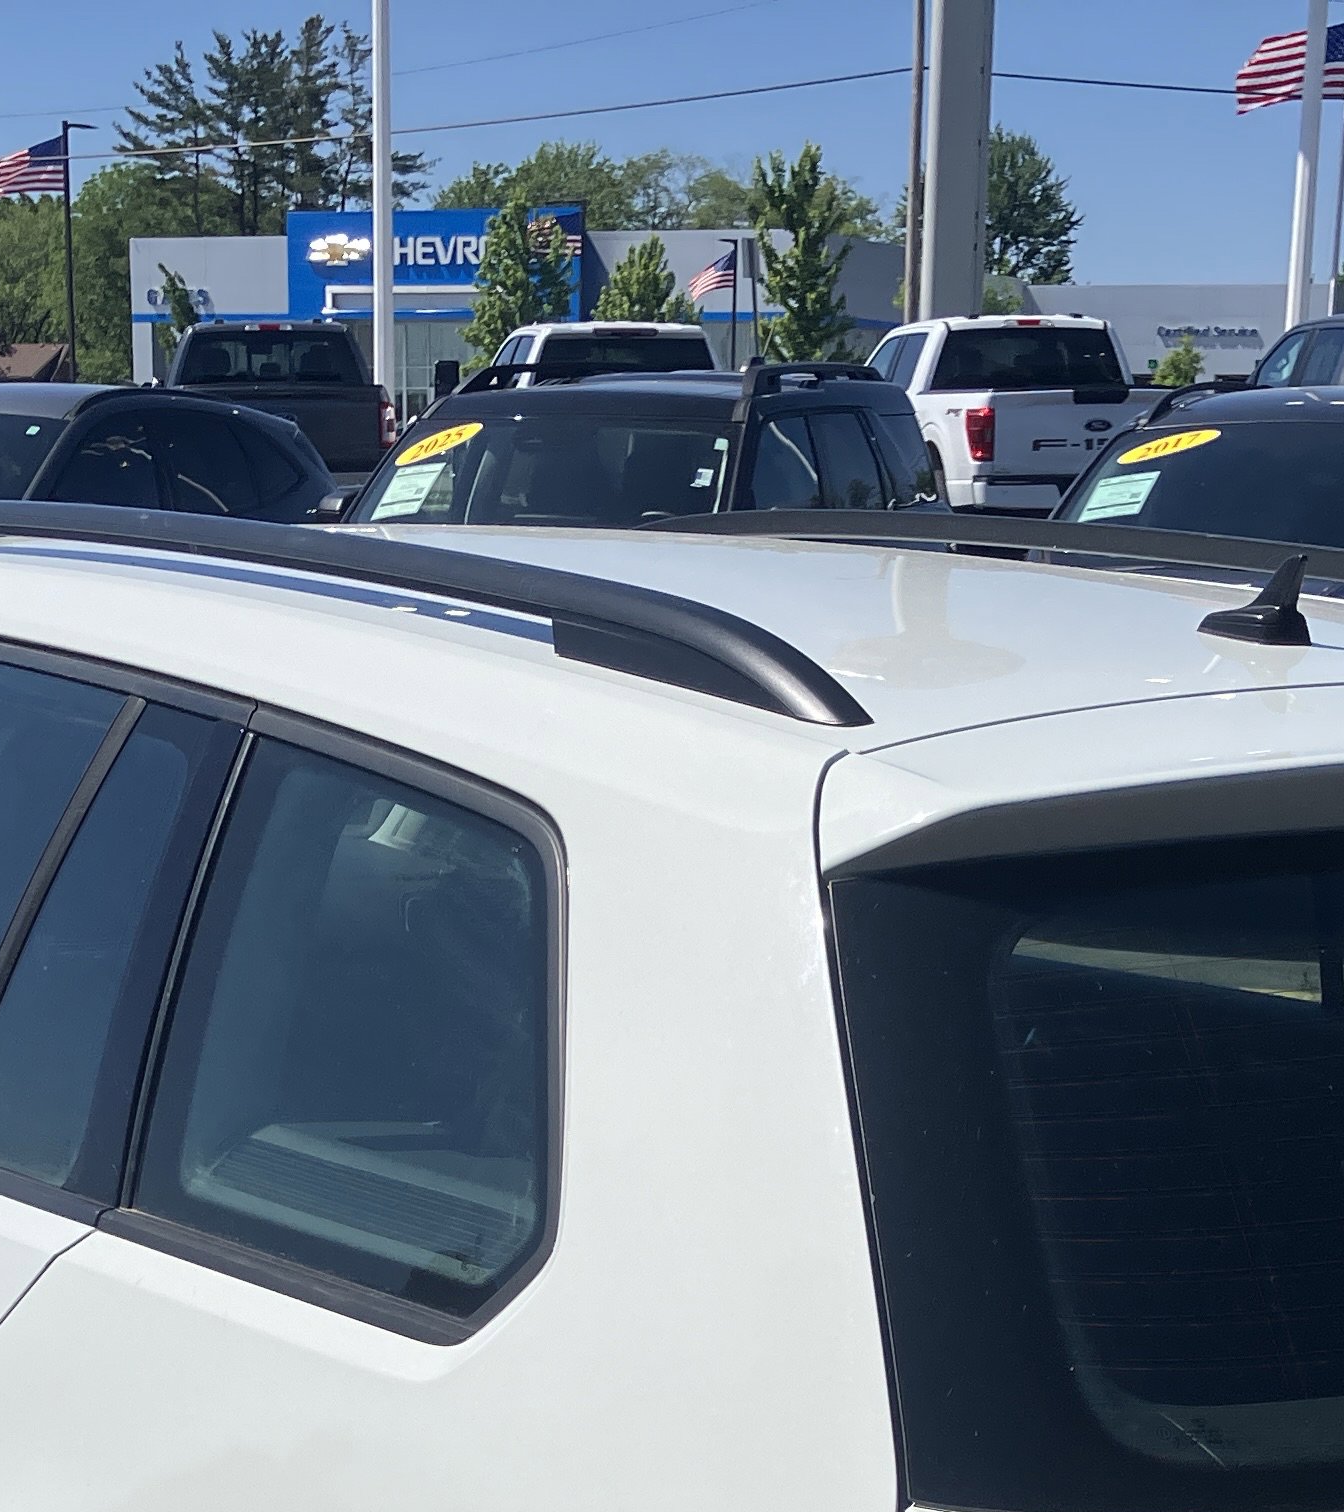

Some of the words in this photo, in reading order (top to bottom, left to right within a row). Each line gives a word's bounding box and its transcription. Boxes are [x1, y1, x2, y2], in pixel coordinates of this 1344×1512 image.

[410, 427, 467, 460] 2025
[1032, 438, 1109, 451] F-15
[1137, 432, 1202, 459] 2017
